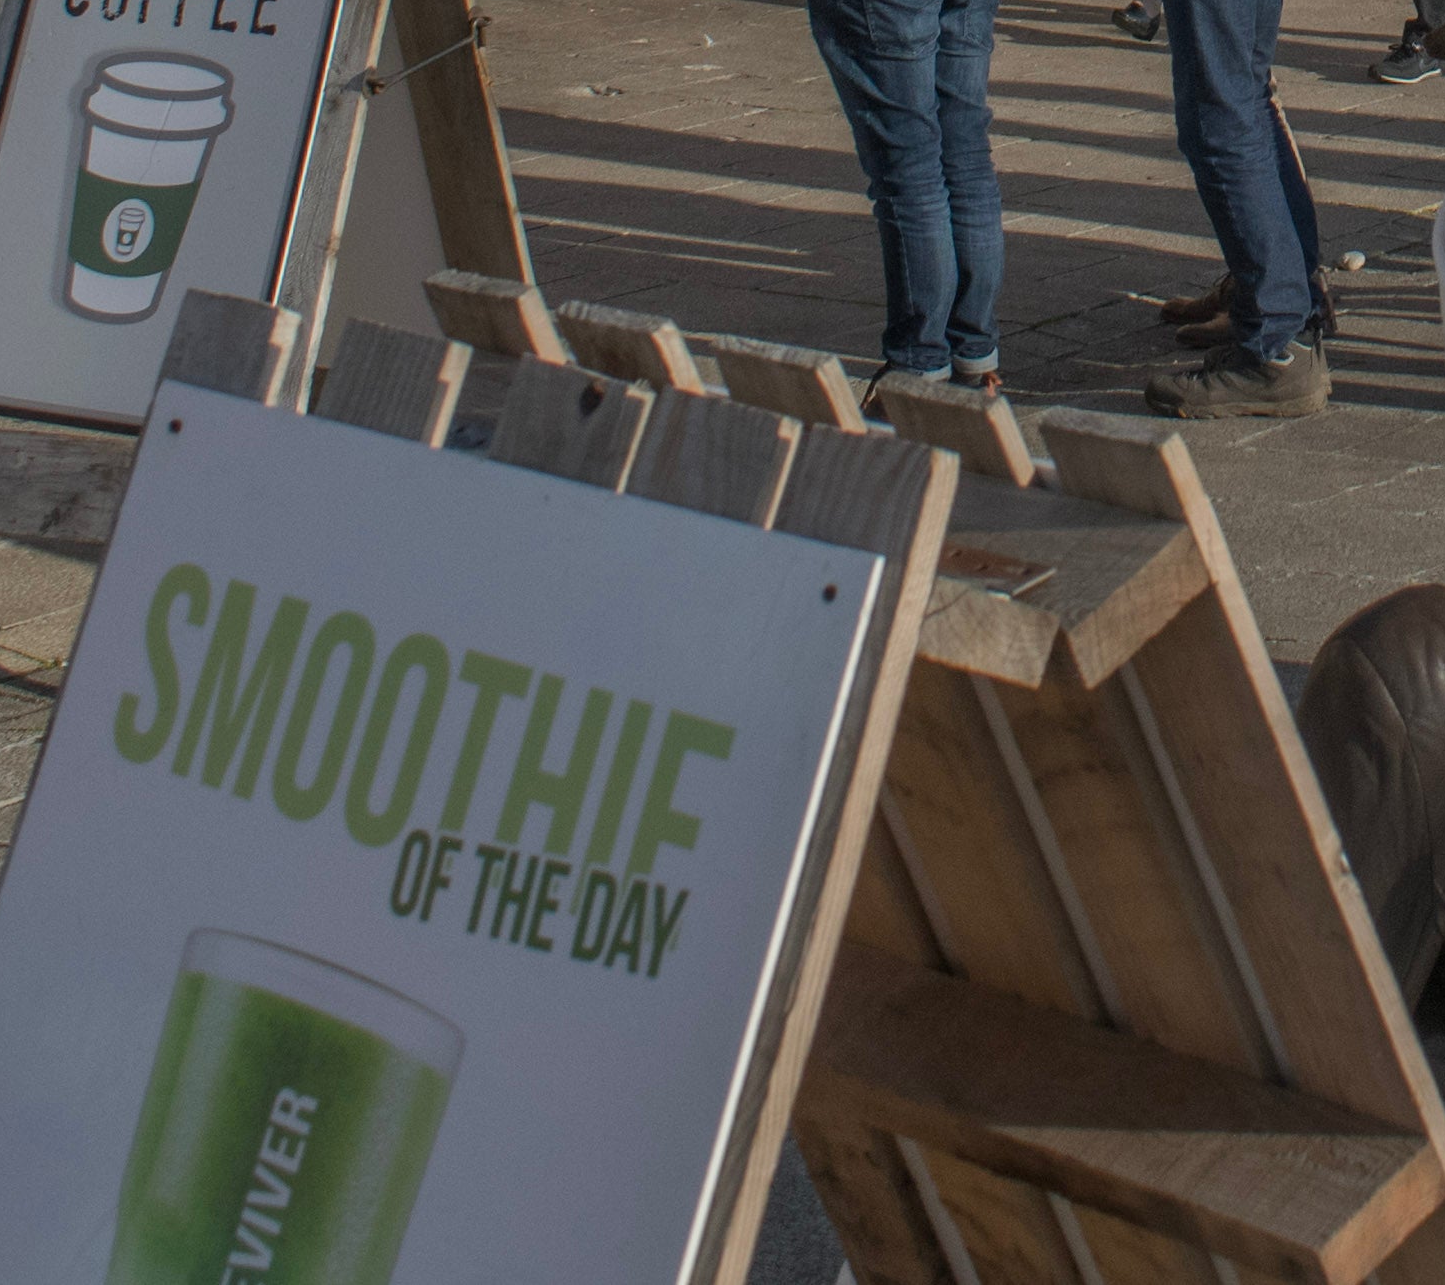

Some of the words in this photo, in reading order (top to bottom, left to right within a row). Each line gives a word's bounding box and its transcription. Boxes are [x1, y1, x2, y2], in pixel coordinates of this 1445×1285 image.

[111, 561, 738, 891] SMOOTHIE
[389, 828, 464, 923] OF
[466, 842, 572, 954] THE
[569, 868, 691, 981] DAY
